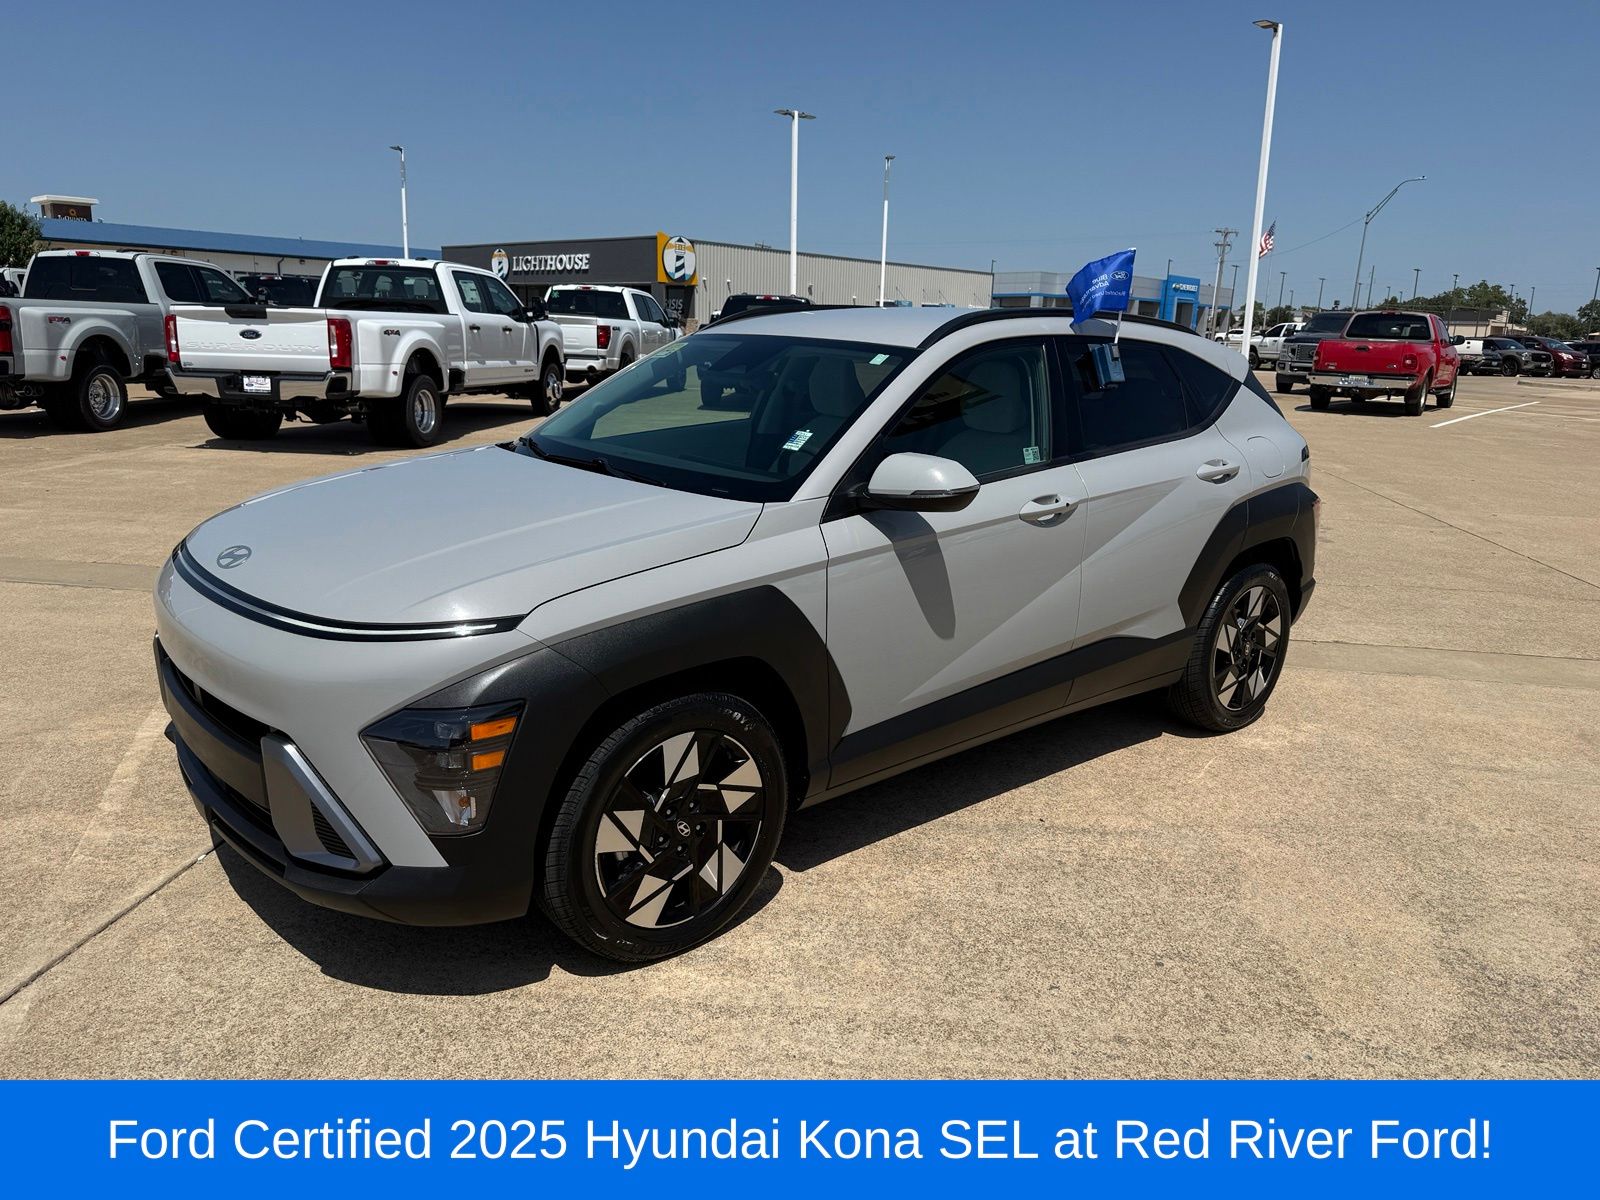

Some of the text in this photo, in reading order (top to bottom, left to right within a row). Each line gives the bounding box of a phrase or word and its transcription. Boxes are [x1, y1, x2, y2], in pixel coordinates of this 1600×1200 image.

[512, 253, 590, 272] LIGHTHOUSE
[186, 341, 321, 353] SUPER DUTY
